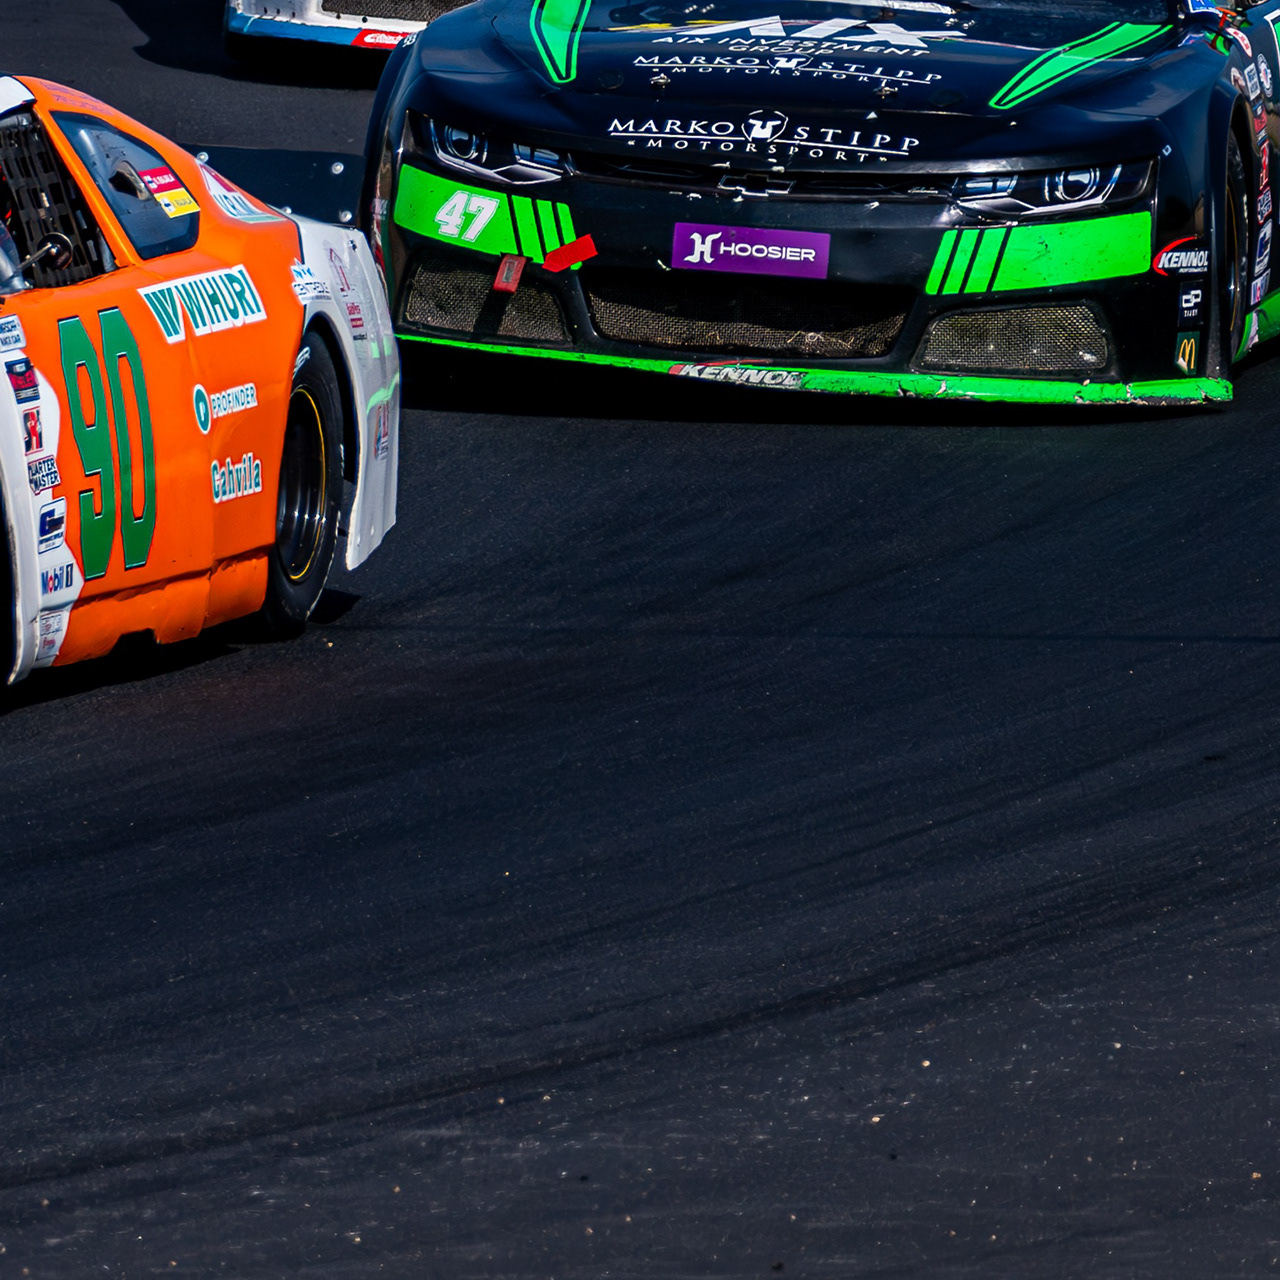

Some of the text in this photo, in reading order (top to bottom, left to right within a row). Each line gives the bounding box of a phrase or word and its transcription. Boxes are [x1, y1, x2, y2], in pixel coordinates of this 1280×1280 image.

[717, 37, 931, 57] INVESTMENT
[728, 45, 835, 55] GROUP
[633, 55, 942, 81] MARKO STIPP
[608, 118, 920, 151] MARKO STIPP
[435, 190, 500, 243] 47
[720, 242, 816, 263] HOOSIER
[1158, 250, 1208, 269] KENNOL
[172, 268, 263, 335] WIHURI
[679, 364, 804, 388] KENNOL
[211, 384, 258, 418] PROFINDER
[56, 306, 156, 580] 90
[41, 567, 65, 595] Mobil
